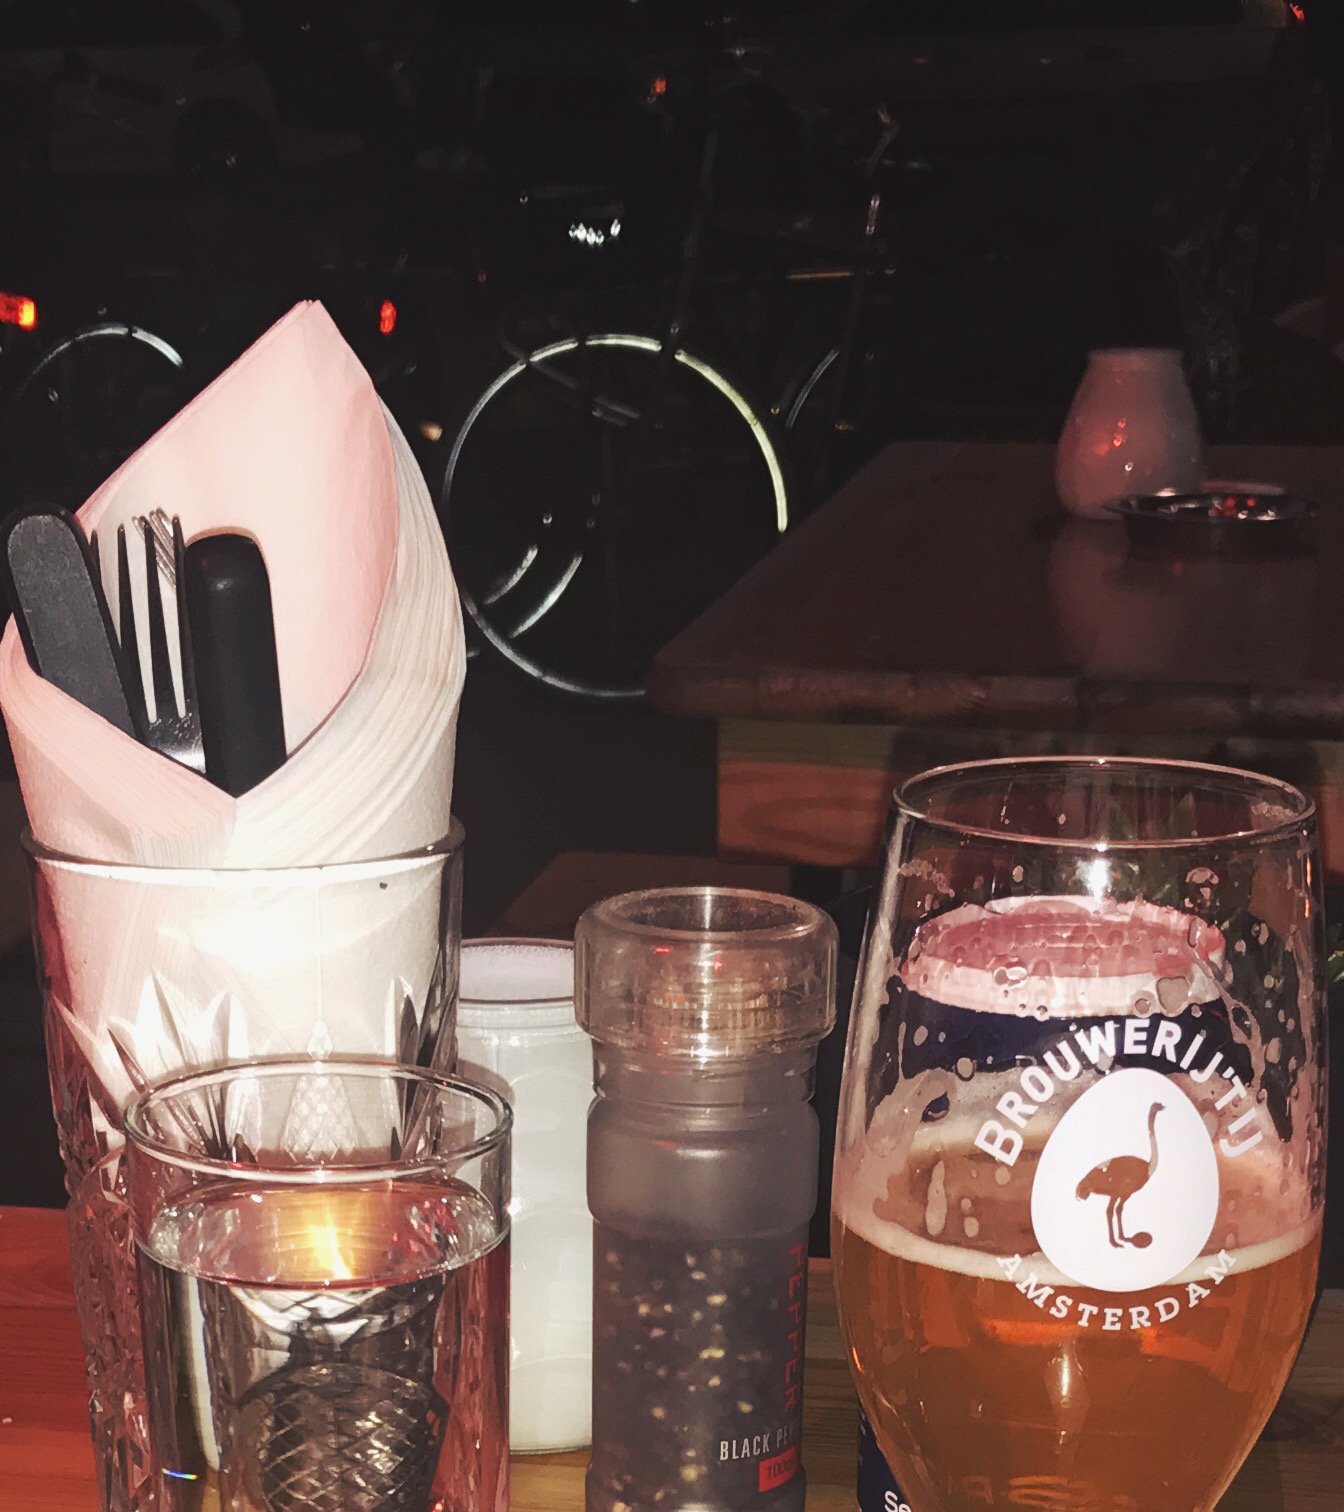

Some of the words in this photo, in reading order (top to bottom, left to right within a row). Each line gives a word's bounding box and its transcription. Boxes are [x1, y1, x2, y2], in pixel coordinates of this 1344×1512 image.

[973, 1018, 1224, 1167] BROUWERIJ
[996, 1249, 1237, 1331] AMSTERDAM
[719, 1431, 771, 1462] BLACK
